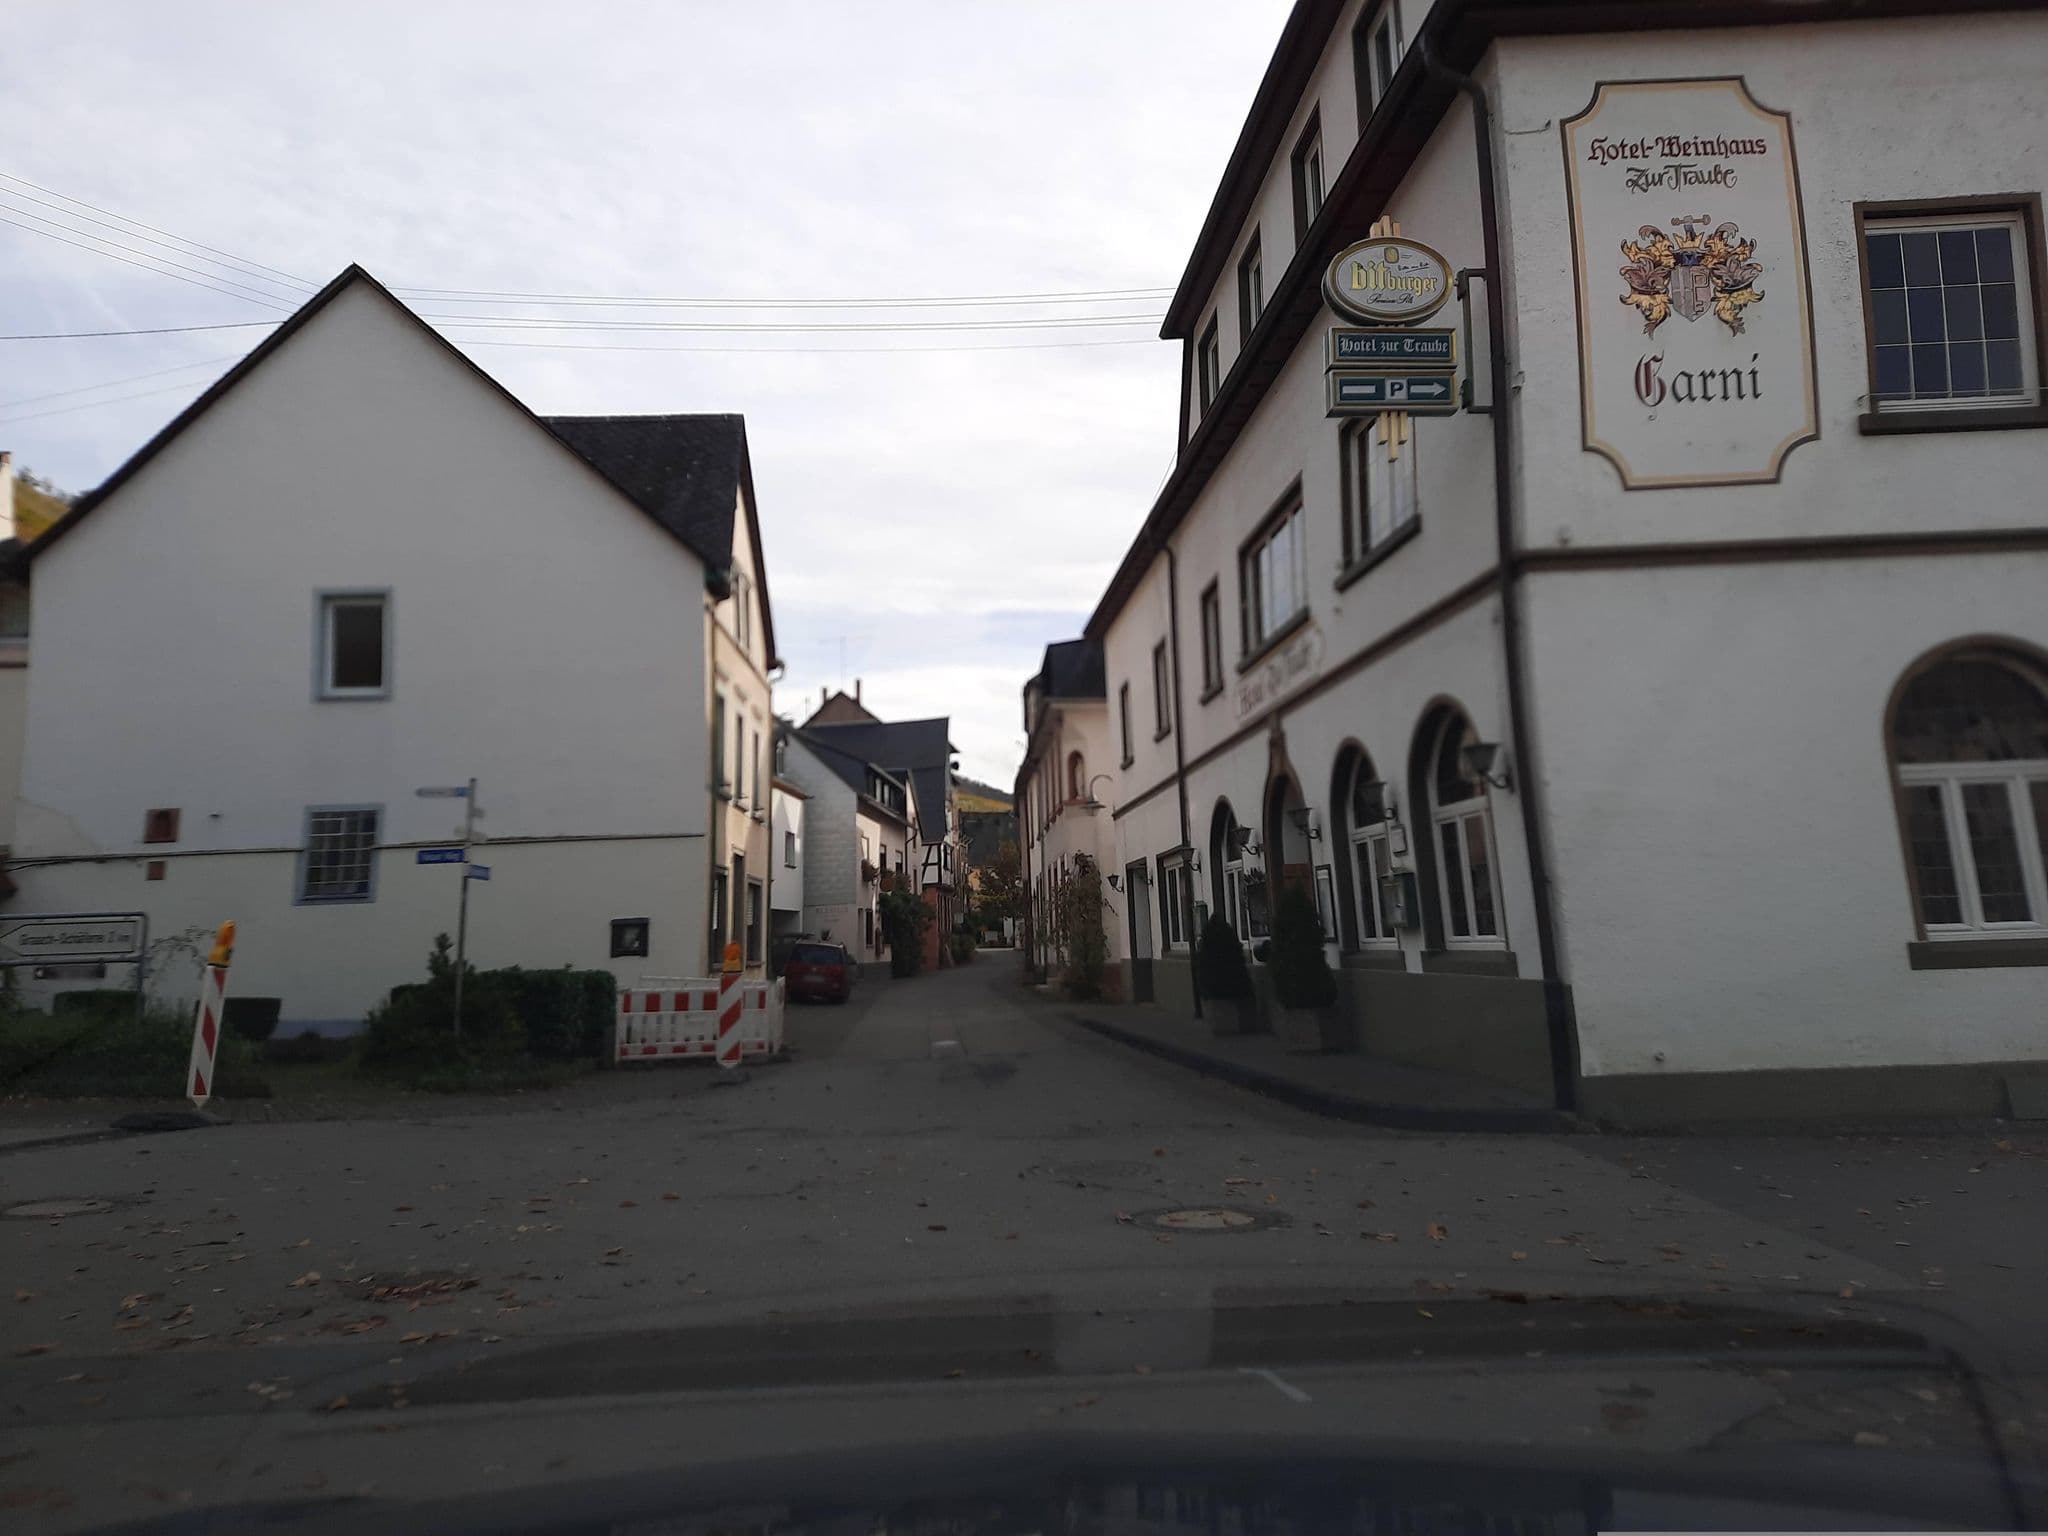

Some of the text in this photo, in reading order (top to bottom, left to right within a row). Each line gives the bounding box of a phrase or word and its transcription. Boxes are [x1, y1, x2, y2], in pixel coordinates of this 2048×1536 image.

[1340, 337, 1449, 352] Hotel zur Traube
[1390, 382, 1404, 397] P
[1634, 350, 1763, 421] Garni
